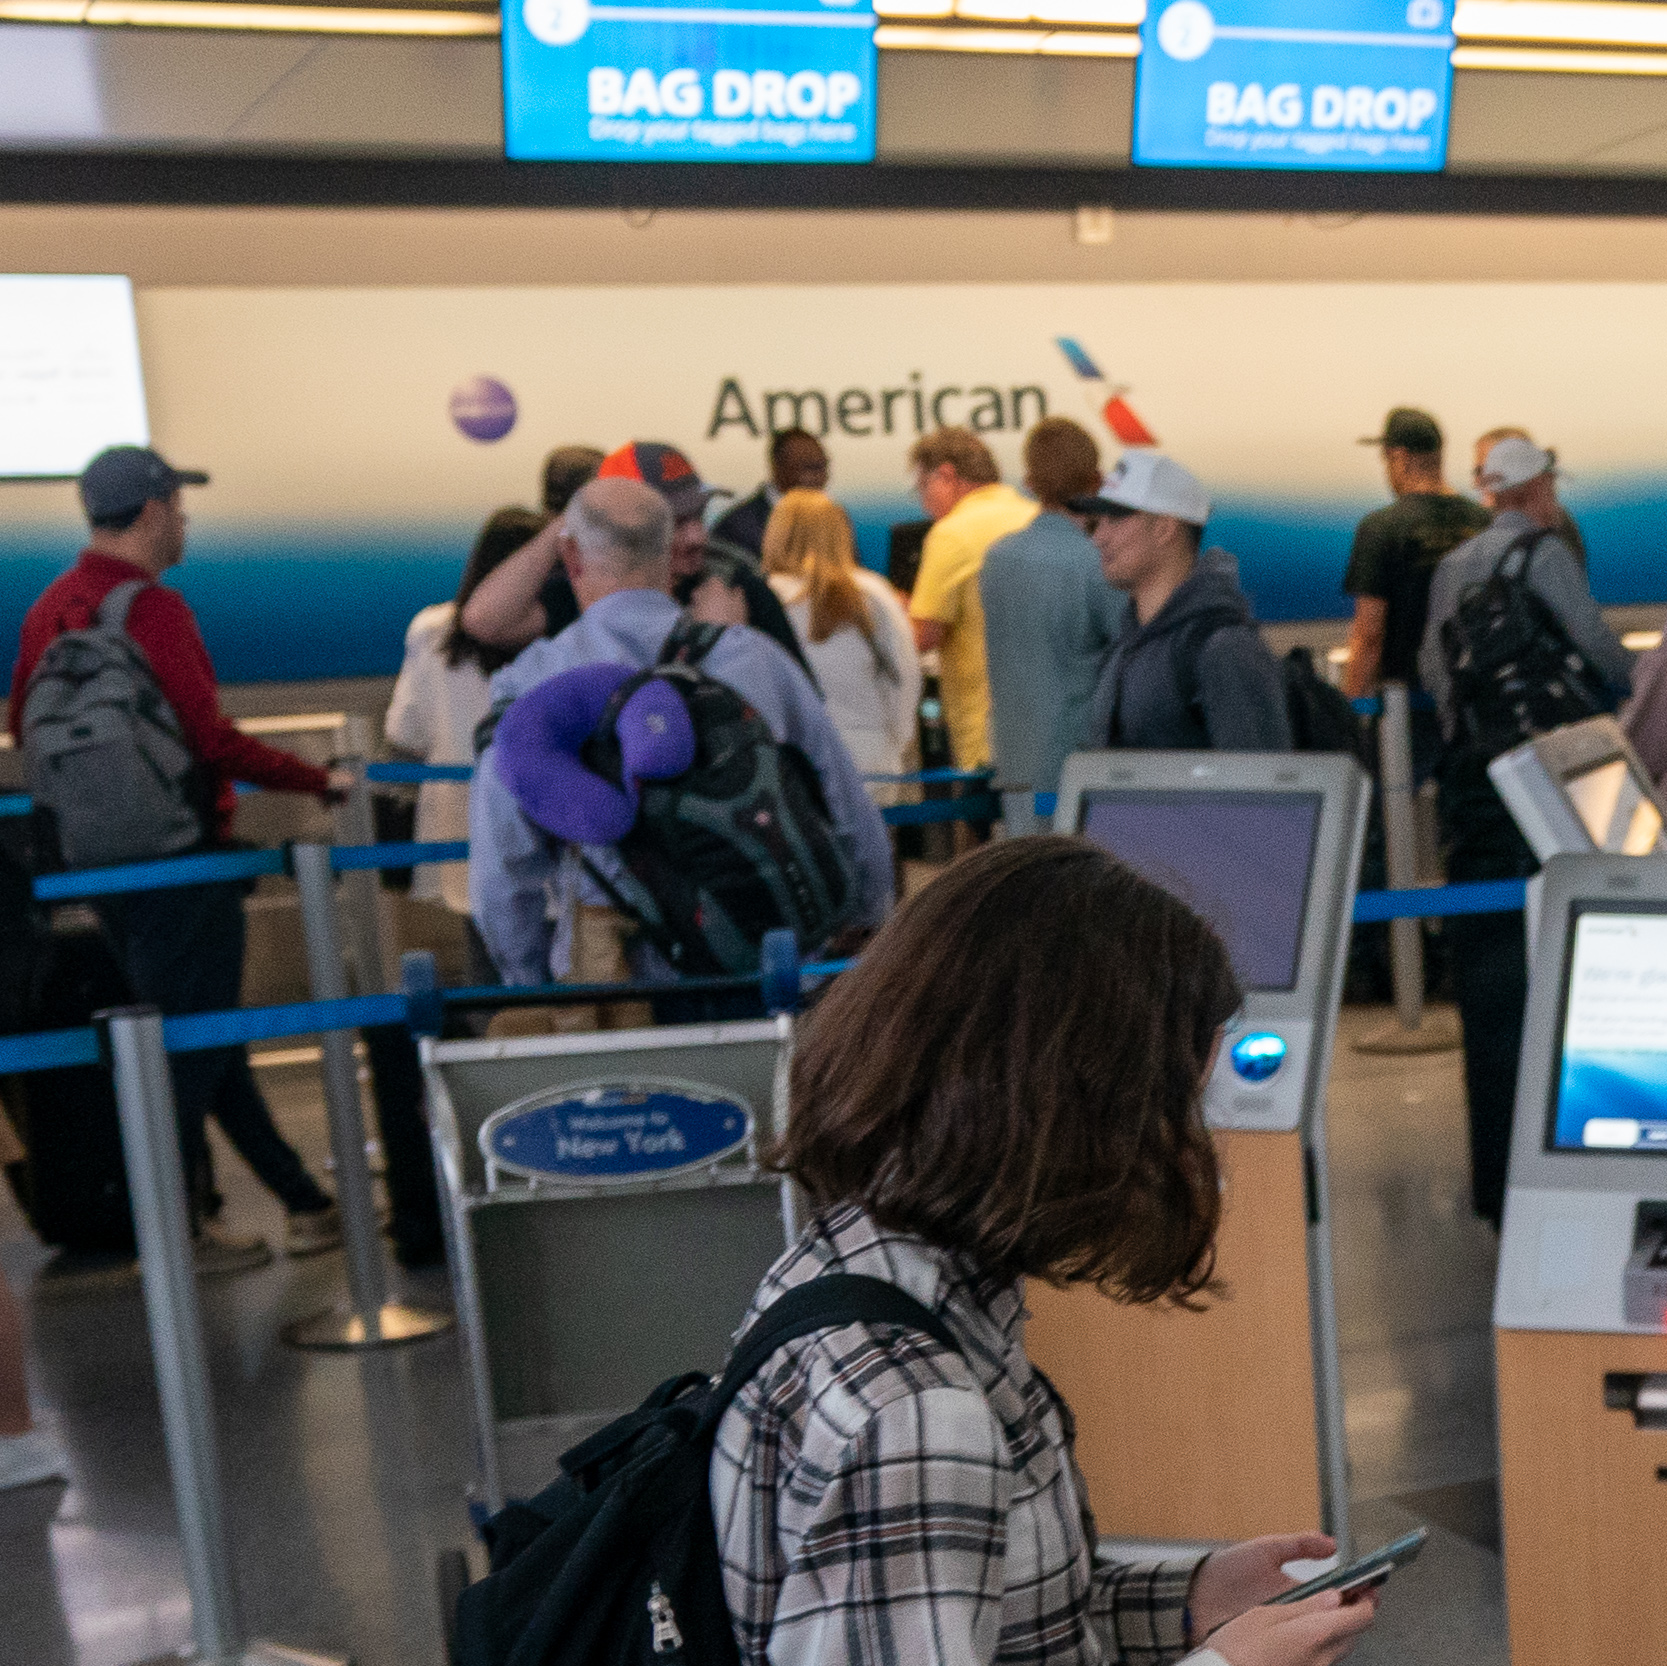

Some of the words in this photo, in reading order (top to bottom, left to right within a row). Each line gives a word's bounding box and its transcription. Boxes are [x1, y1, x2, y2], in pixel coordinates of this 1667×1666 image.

[588, 67, 703, 117] BAG
[712, 69, 861, 119] DROP
[1206, 81, 1303, 128] BAG
[1311, 84, 1437, 130] DROP
[706, 371, 1049, 440] American
[556, 1136, 619, 1160] New
[623, 1126, 686, 1155] York
